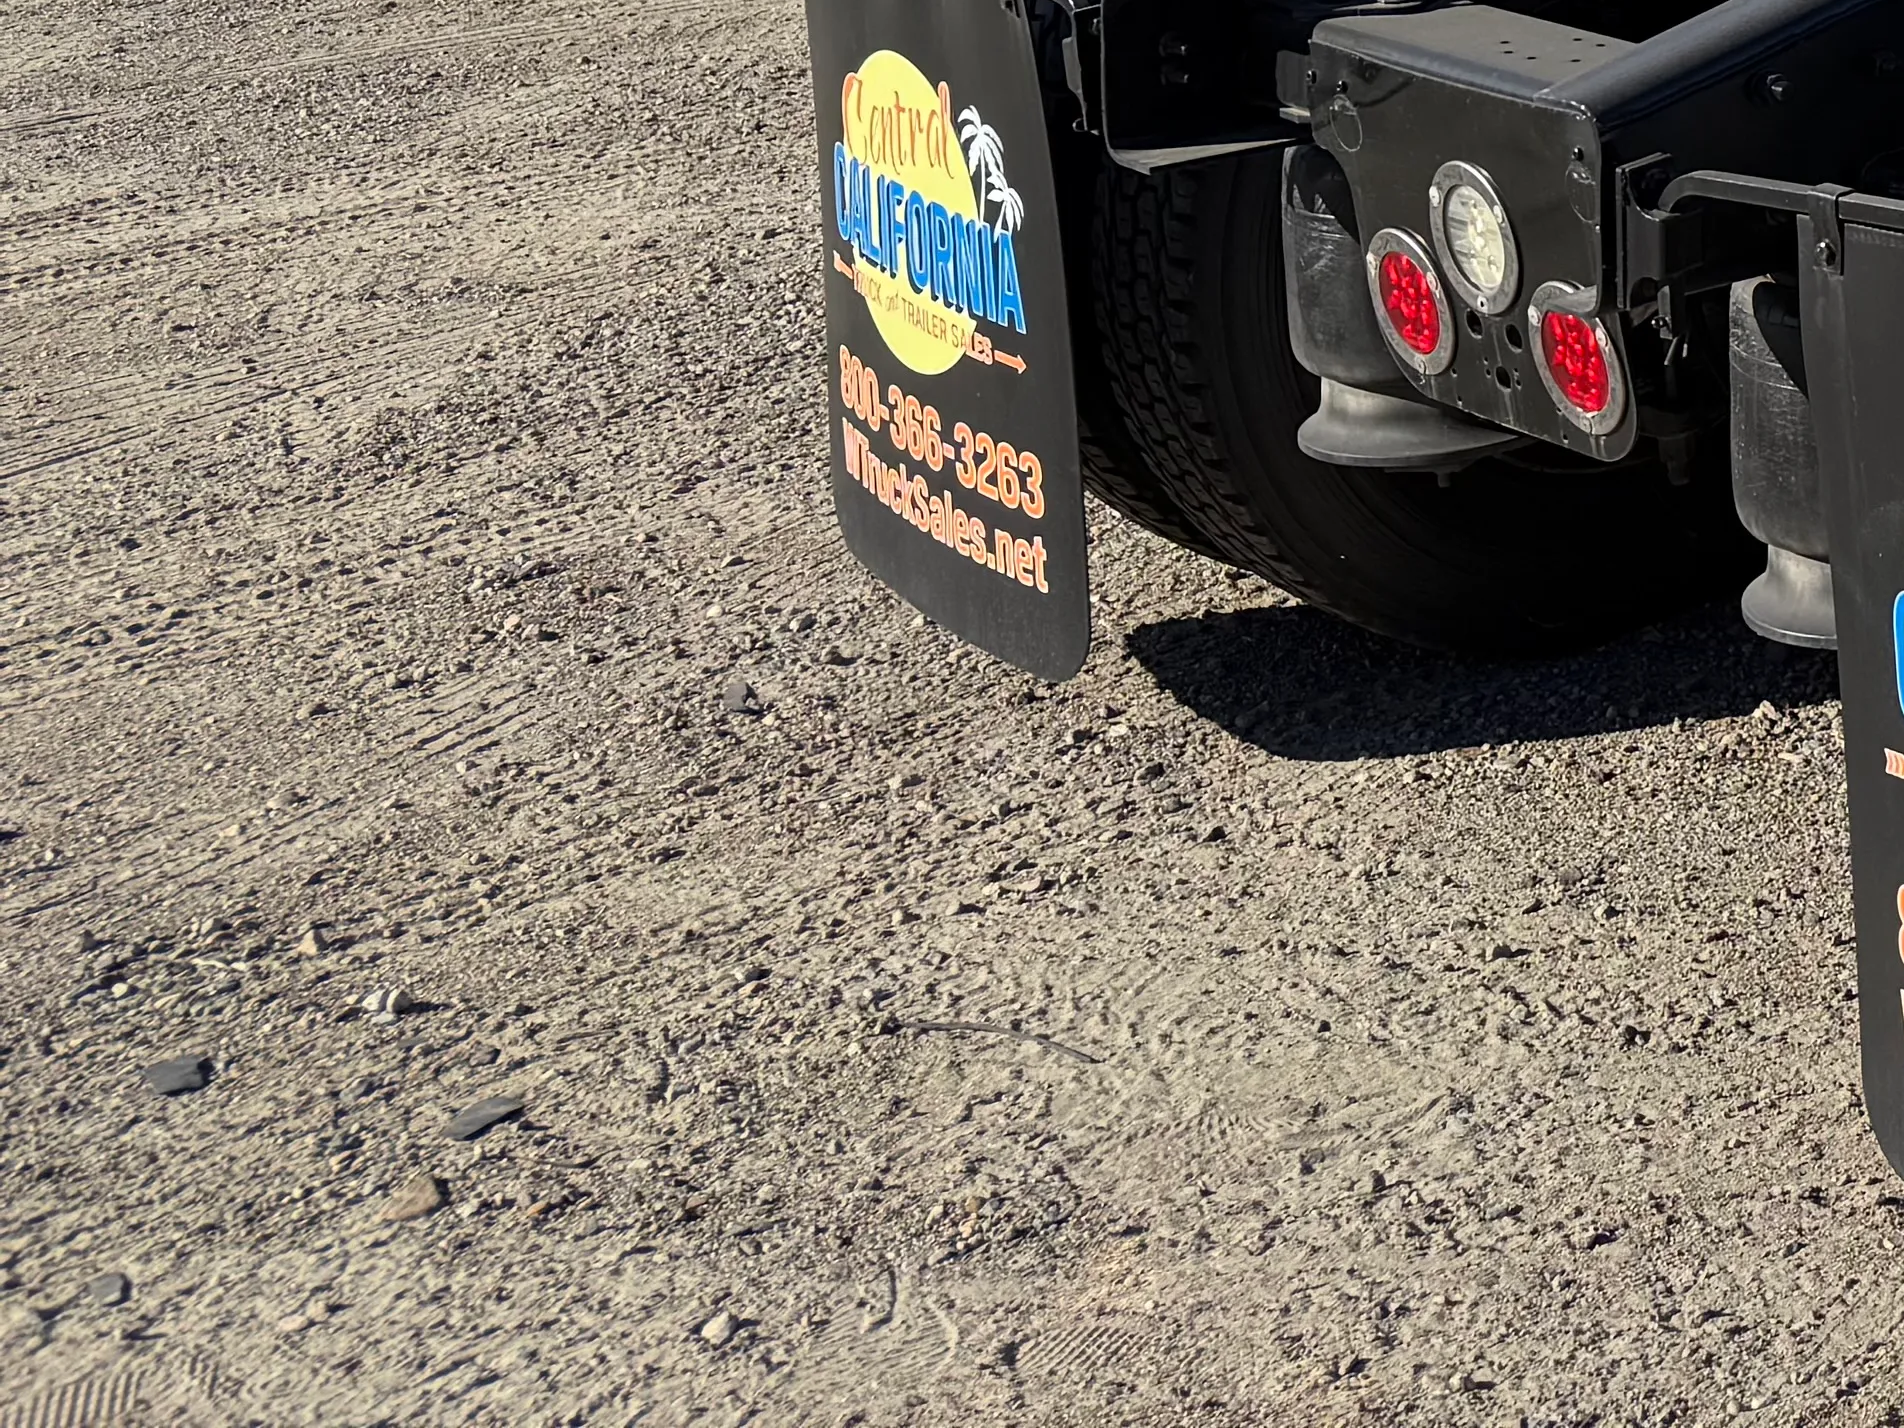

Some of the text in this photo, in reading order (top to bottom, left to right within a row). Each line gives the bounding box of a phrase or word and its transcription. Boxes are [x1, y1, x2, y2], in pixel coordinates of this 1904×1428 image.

[842, 72, 954, 179] Central
[833, 141, 1027, 334] CALIFORNIA
[852, 263, 883, 308] TRUCK
[901, 296, 948, 342] TRAILER
[951, 323, 993, 365] SALES
[839, 344, 1045, 519] 800-366-3263
[842, 417, 1049, 594] WTruckSales.net
